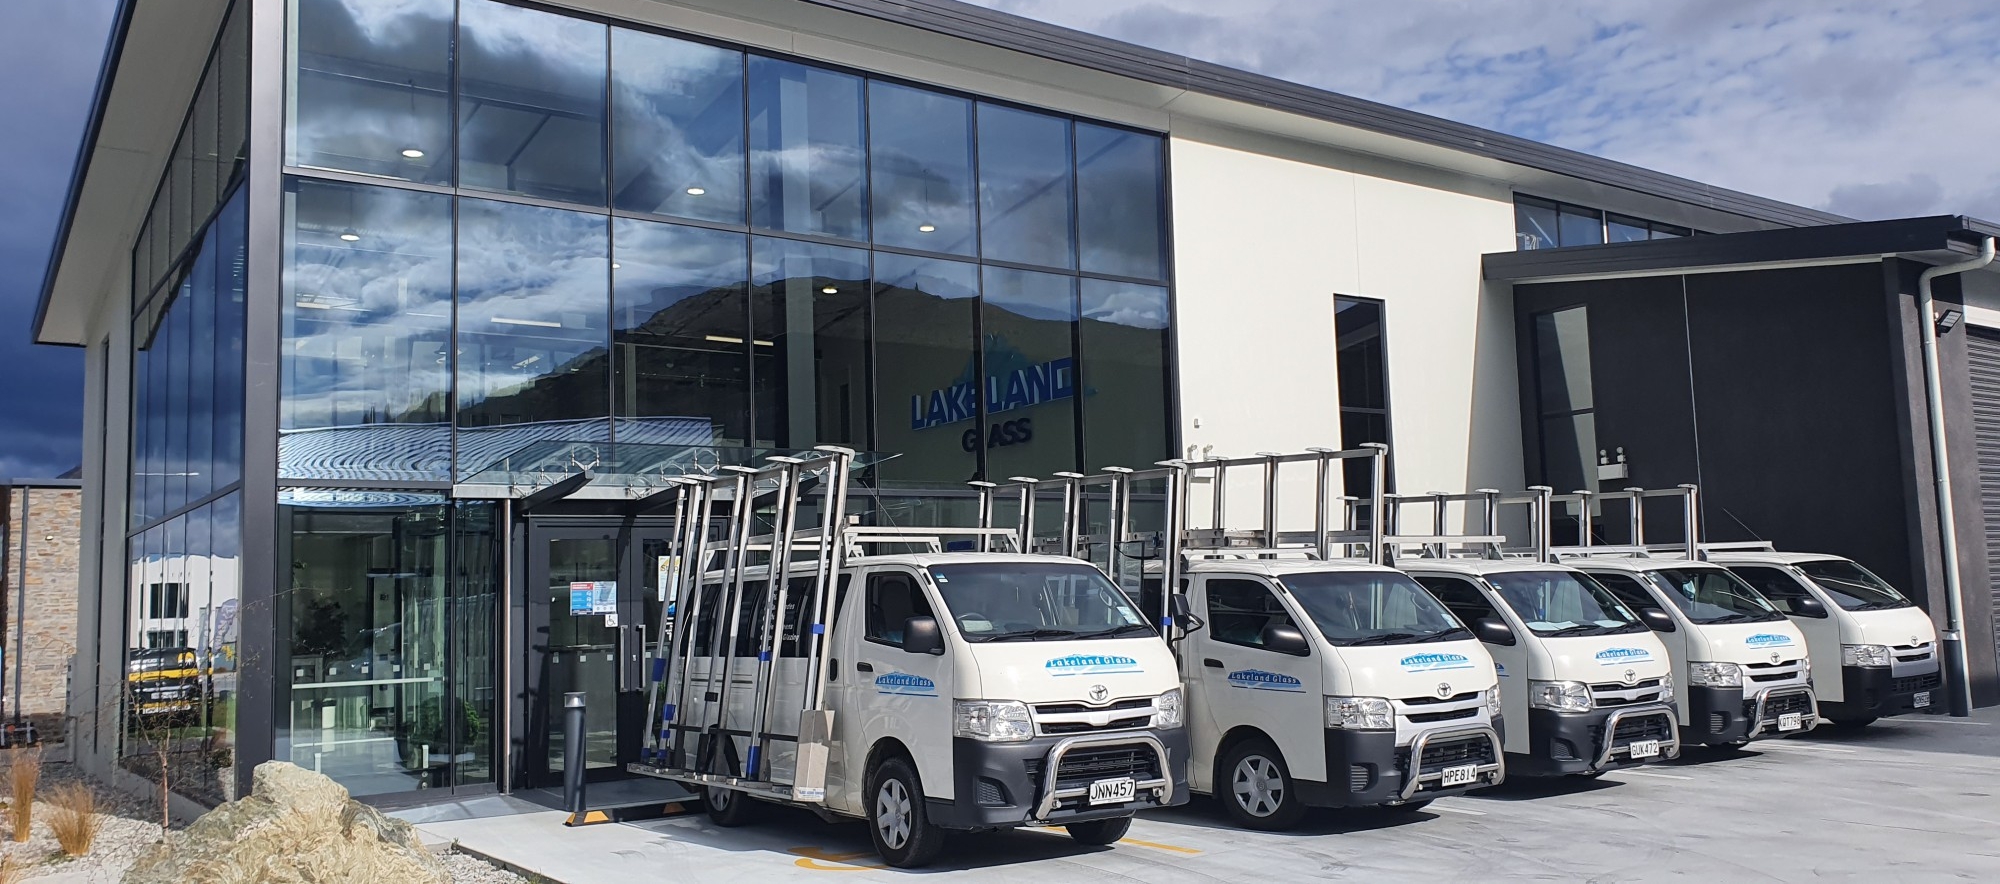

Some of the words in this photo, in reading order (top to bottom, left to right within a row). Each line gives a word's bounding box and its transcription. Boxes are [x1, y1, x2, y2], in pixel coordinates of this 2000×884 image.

[962, 417, 1033, 452] GASS
[1050, 658, 1101, 667] Lakeland
[1104, 656, 1132, 664] Glass
[1403, 656, 1441, 664] Lakeland
[878, 676, 910, 684] Lakeland
[911, 678, 931, 686] Glass
[1231, 673, 1270, 682] Lakeland
[1272, 676, 1297, 684] Glass
[1632, 743, 1658, 755] GUK472
[1444, 767, 1475, 783] HPE814
[1091, 781, 1133, 799] JNN457
